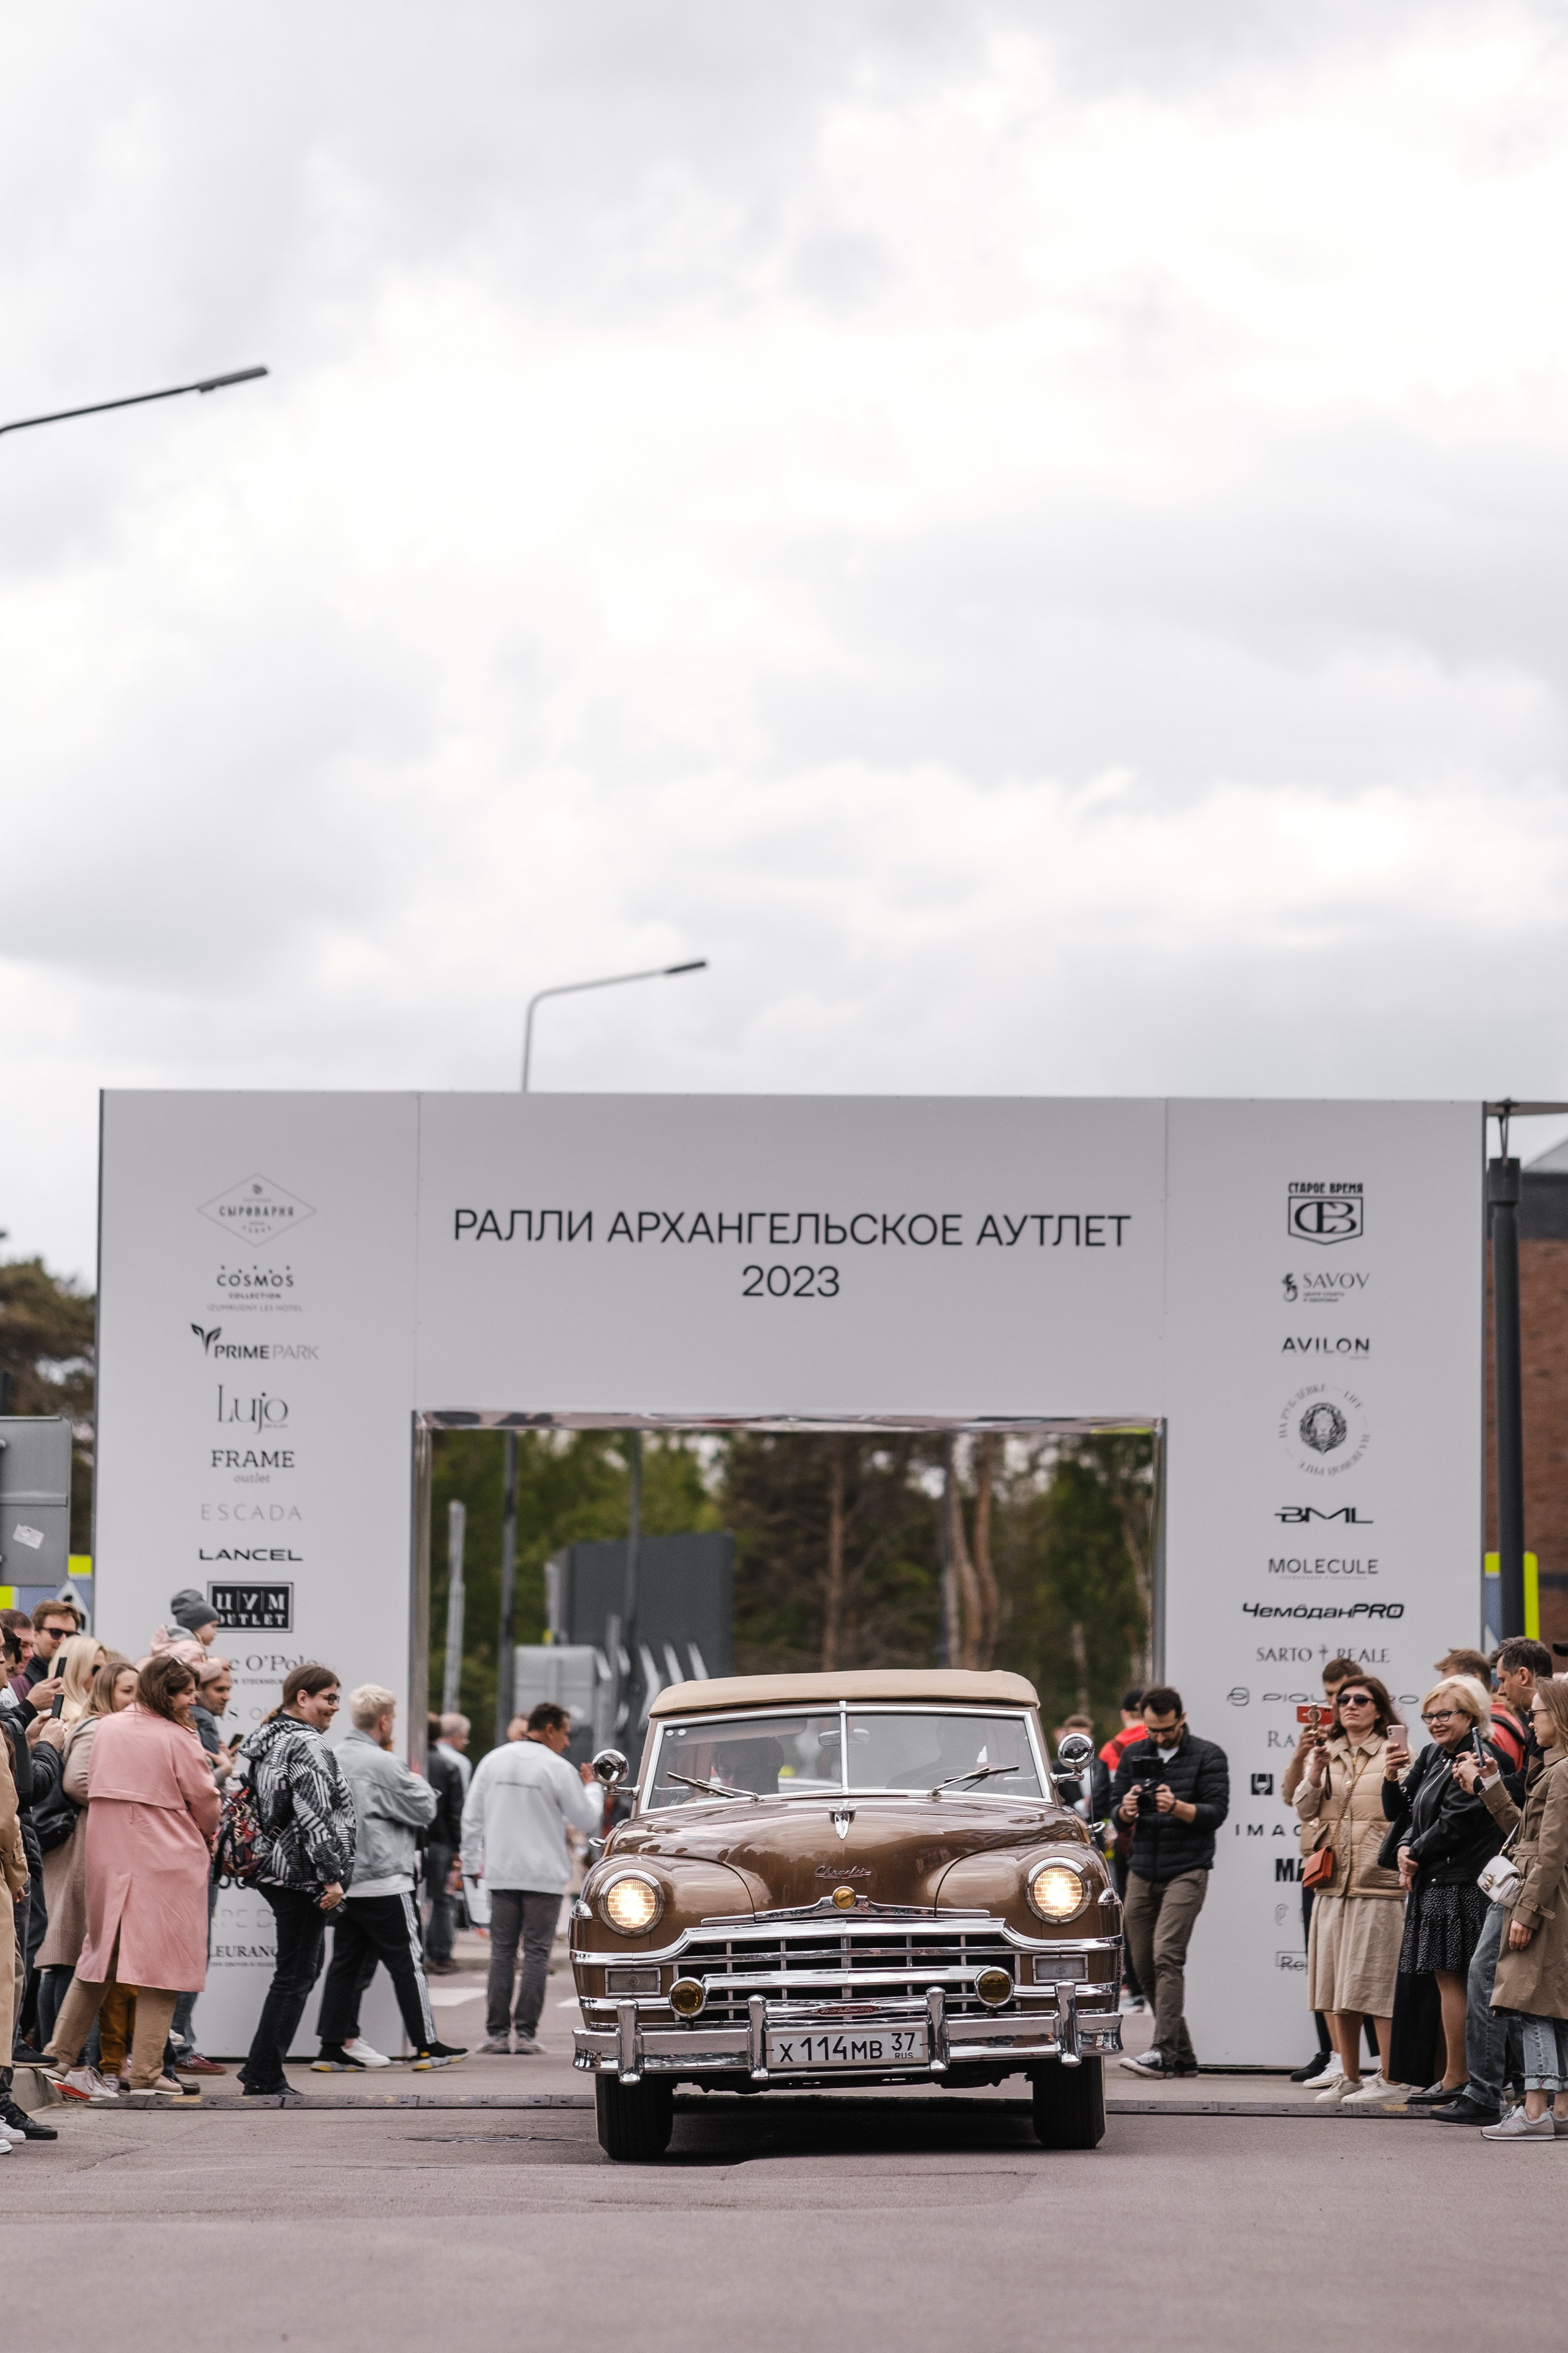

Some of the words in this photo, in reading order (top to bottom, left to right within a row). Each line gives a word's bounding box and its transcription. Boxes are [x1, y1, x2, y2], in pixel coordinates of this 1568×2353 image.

[1288, 1182, 1325, 1193] СТАРОЕ
[1330, 1183, 1363, 1193] ВРЕМЯ
[219, 1206, 294, 1217] СЫРОВАРНЯ
[454, 1209, 594, 1242] РАЛЛИ
[607, 1211, 963, 1246] АРХАНГЕЛЬСКОЕ
[976, 1214, 1132, 1247] АУТЛЕТ
[216, 1274, 294, 1288] COSMOS
[742, 1264, 840, 1297] 2023
[1303, 1272, 1370, 1290] SAVOY
[1282, 1337, 1370, 1353] AVILON
[217, 1384, 288, 1435] Lujo
[211, 1449, 295, 1468] FRAME
[233, 1472, 271, 1484] outlet
[200, 1503, 303, 1522] ESCADA
[198, 1548, 303, 1562] LANCEL
[1268, 1558, 1379, 1574] MOLECULE
[1256, 1647, 1313, 1662] SARTO
[891, 2031, 916, 2051] 37
